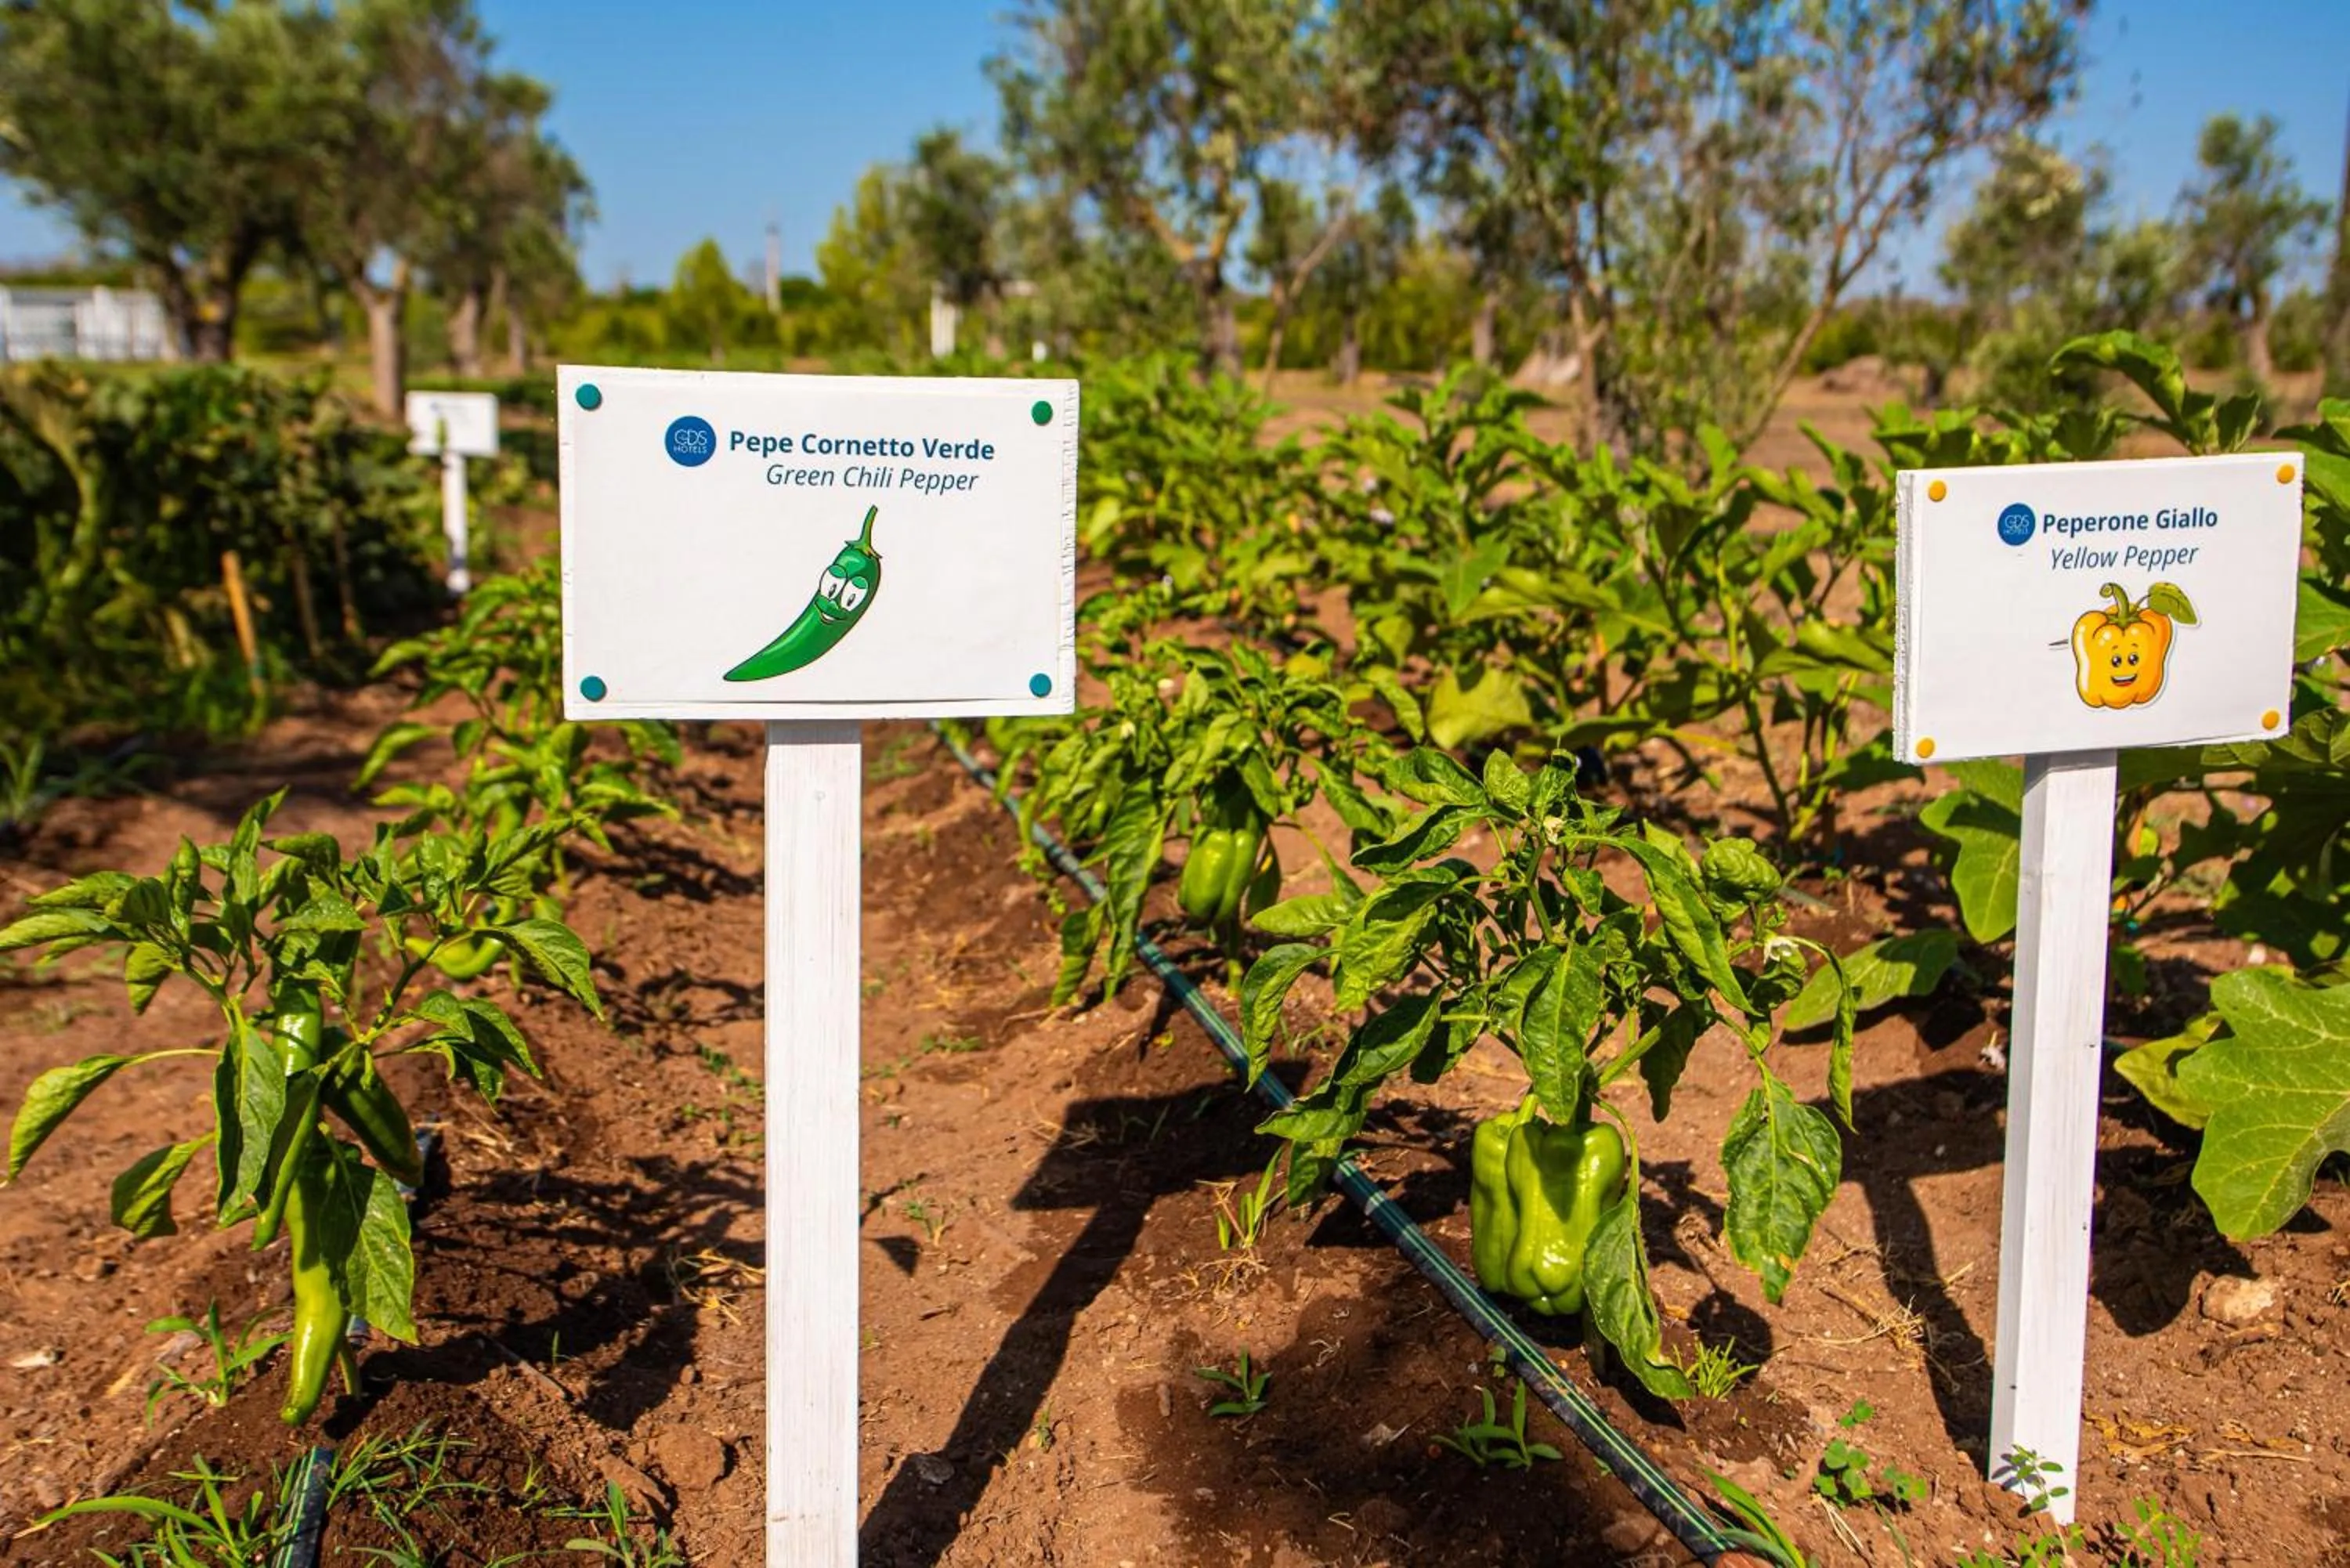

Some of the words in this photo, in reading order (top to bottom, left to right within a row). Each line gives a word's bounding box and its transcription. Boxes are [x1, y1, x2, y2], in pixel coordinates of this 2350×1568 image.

[674, 446, 707, 454] HOTELS
[730, 430, 793, 458] Pepe
[801, 434, 915, 458] Cornetto
[922, 439, 995, 461] Verde
[767, 464, 835, 486] Green
[844, 467, 894, 488] Chili
[900, 468, 979, 496] Pepper
[2043, 514, 2149, 538] Peperone
[2156, 508, 2218, 529] Giallo
[2052, 546, 2119, 570] Yellow
[2124, 546, 2200, 572] Pepper
